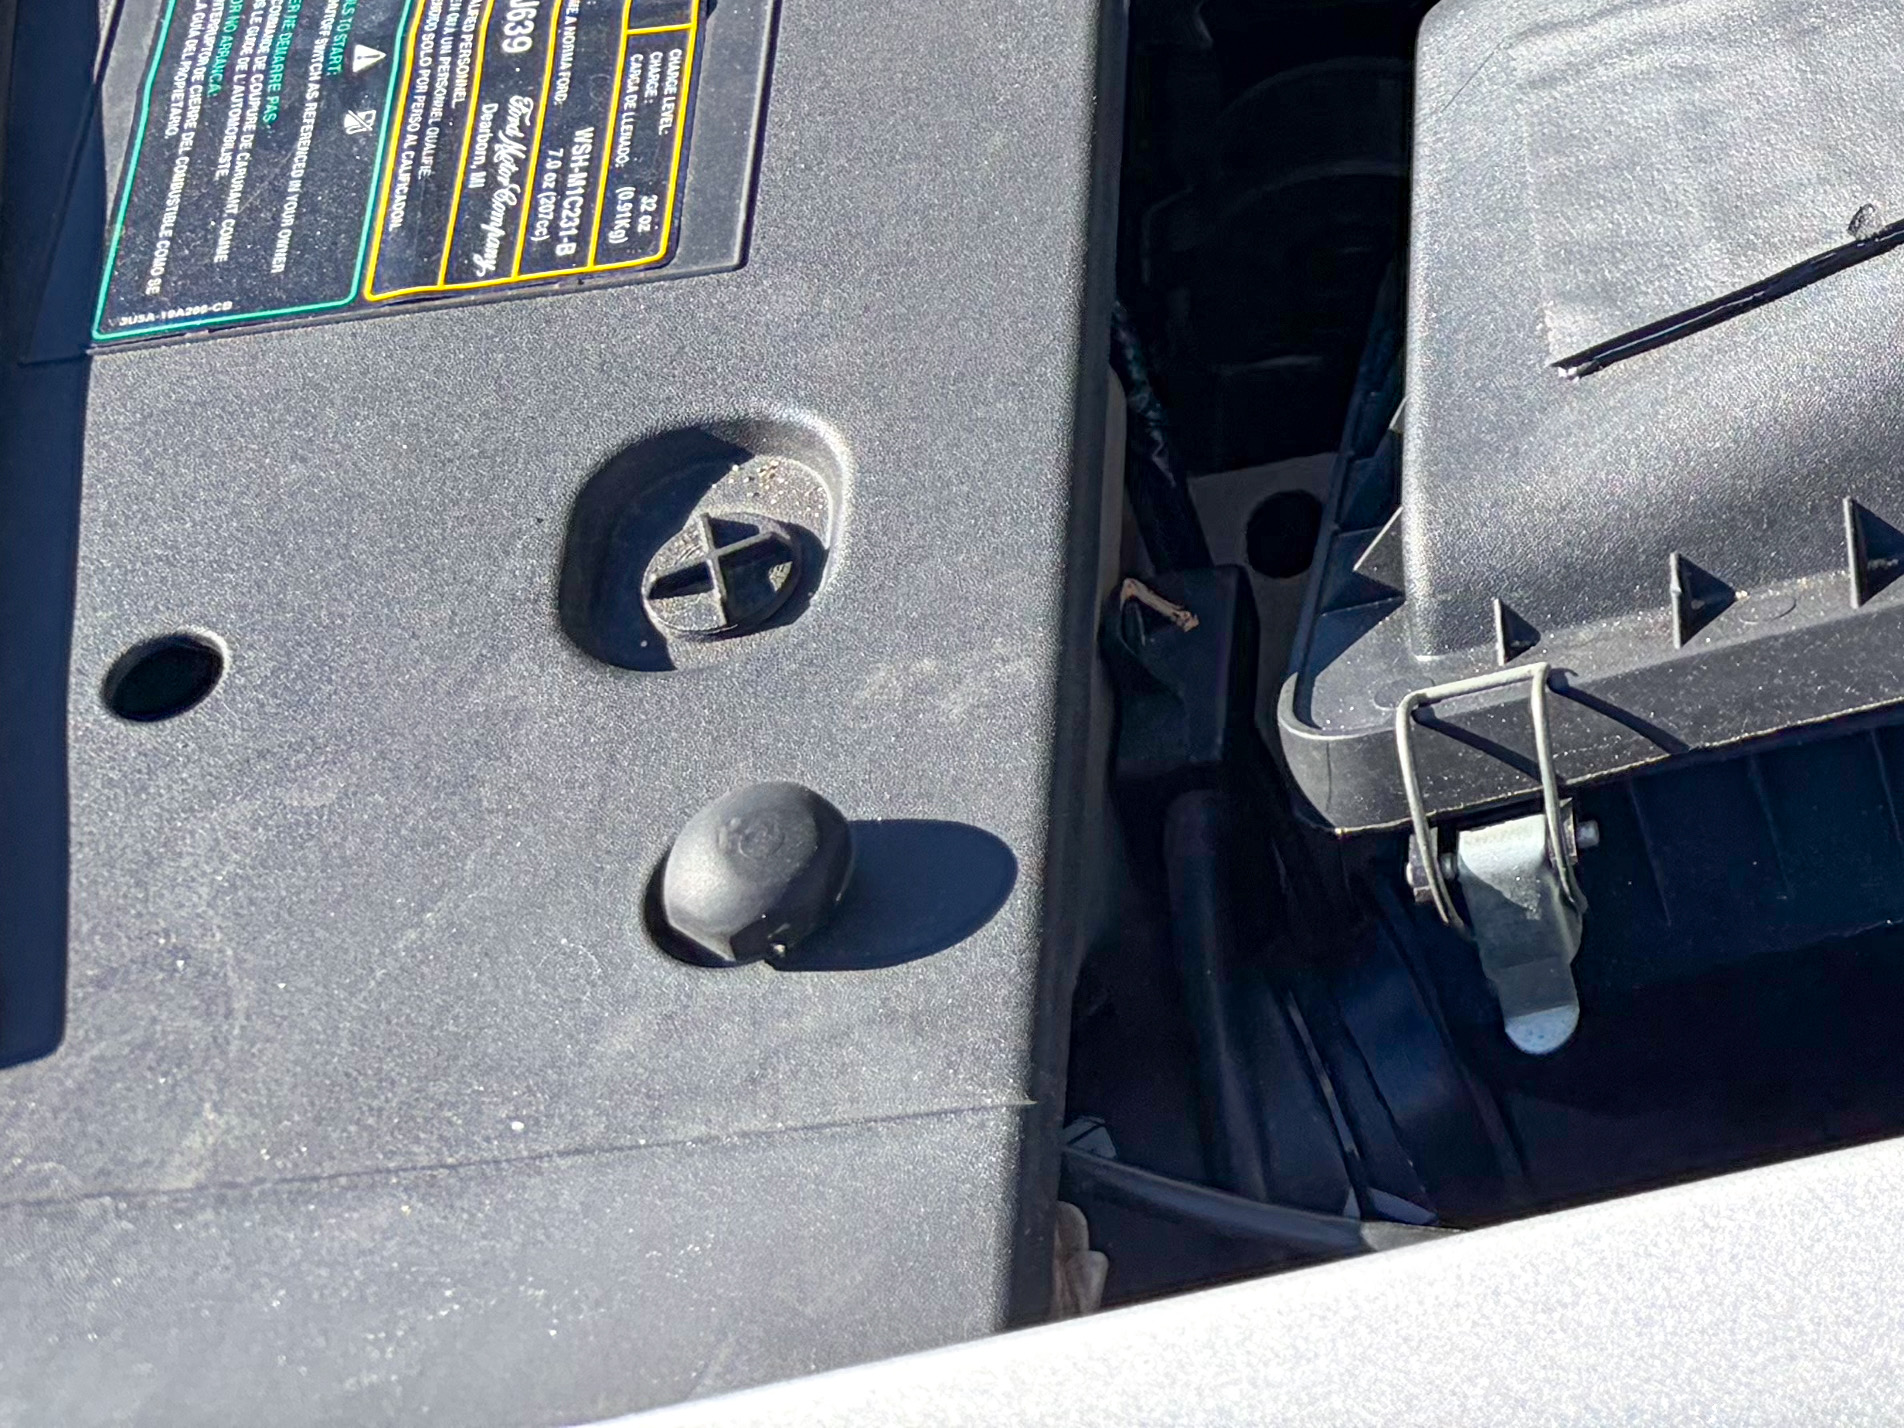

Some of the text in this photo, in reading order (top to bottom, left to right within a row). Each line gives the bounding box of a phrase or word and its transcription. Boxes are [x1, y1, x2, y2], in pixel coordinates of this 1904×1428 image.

[415, 33, 436, 66] SOLO
[663, 48, 681, 94] CHARGE
[644, 51, 662, 97] CHARGE
[622, 94, 636, 110] DE
[290, 101, 319, 178] REFERENCED
[468, 102, 498, 189] Dearborn, MI
[487, 126, 530, 188] Motor
[279, 194, 299, 227] YOUR
[529, 148, 563, 241] 7.0 oz (207cc)
[554, 126, 594, 257] WSH-M1C231-B
[636, 193, 657, 232] 32 oz
